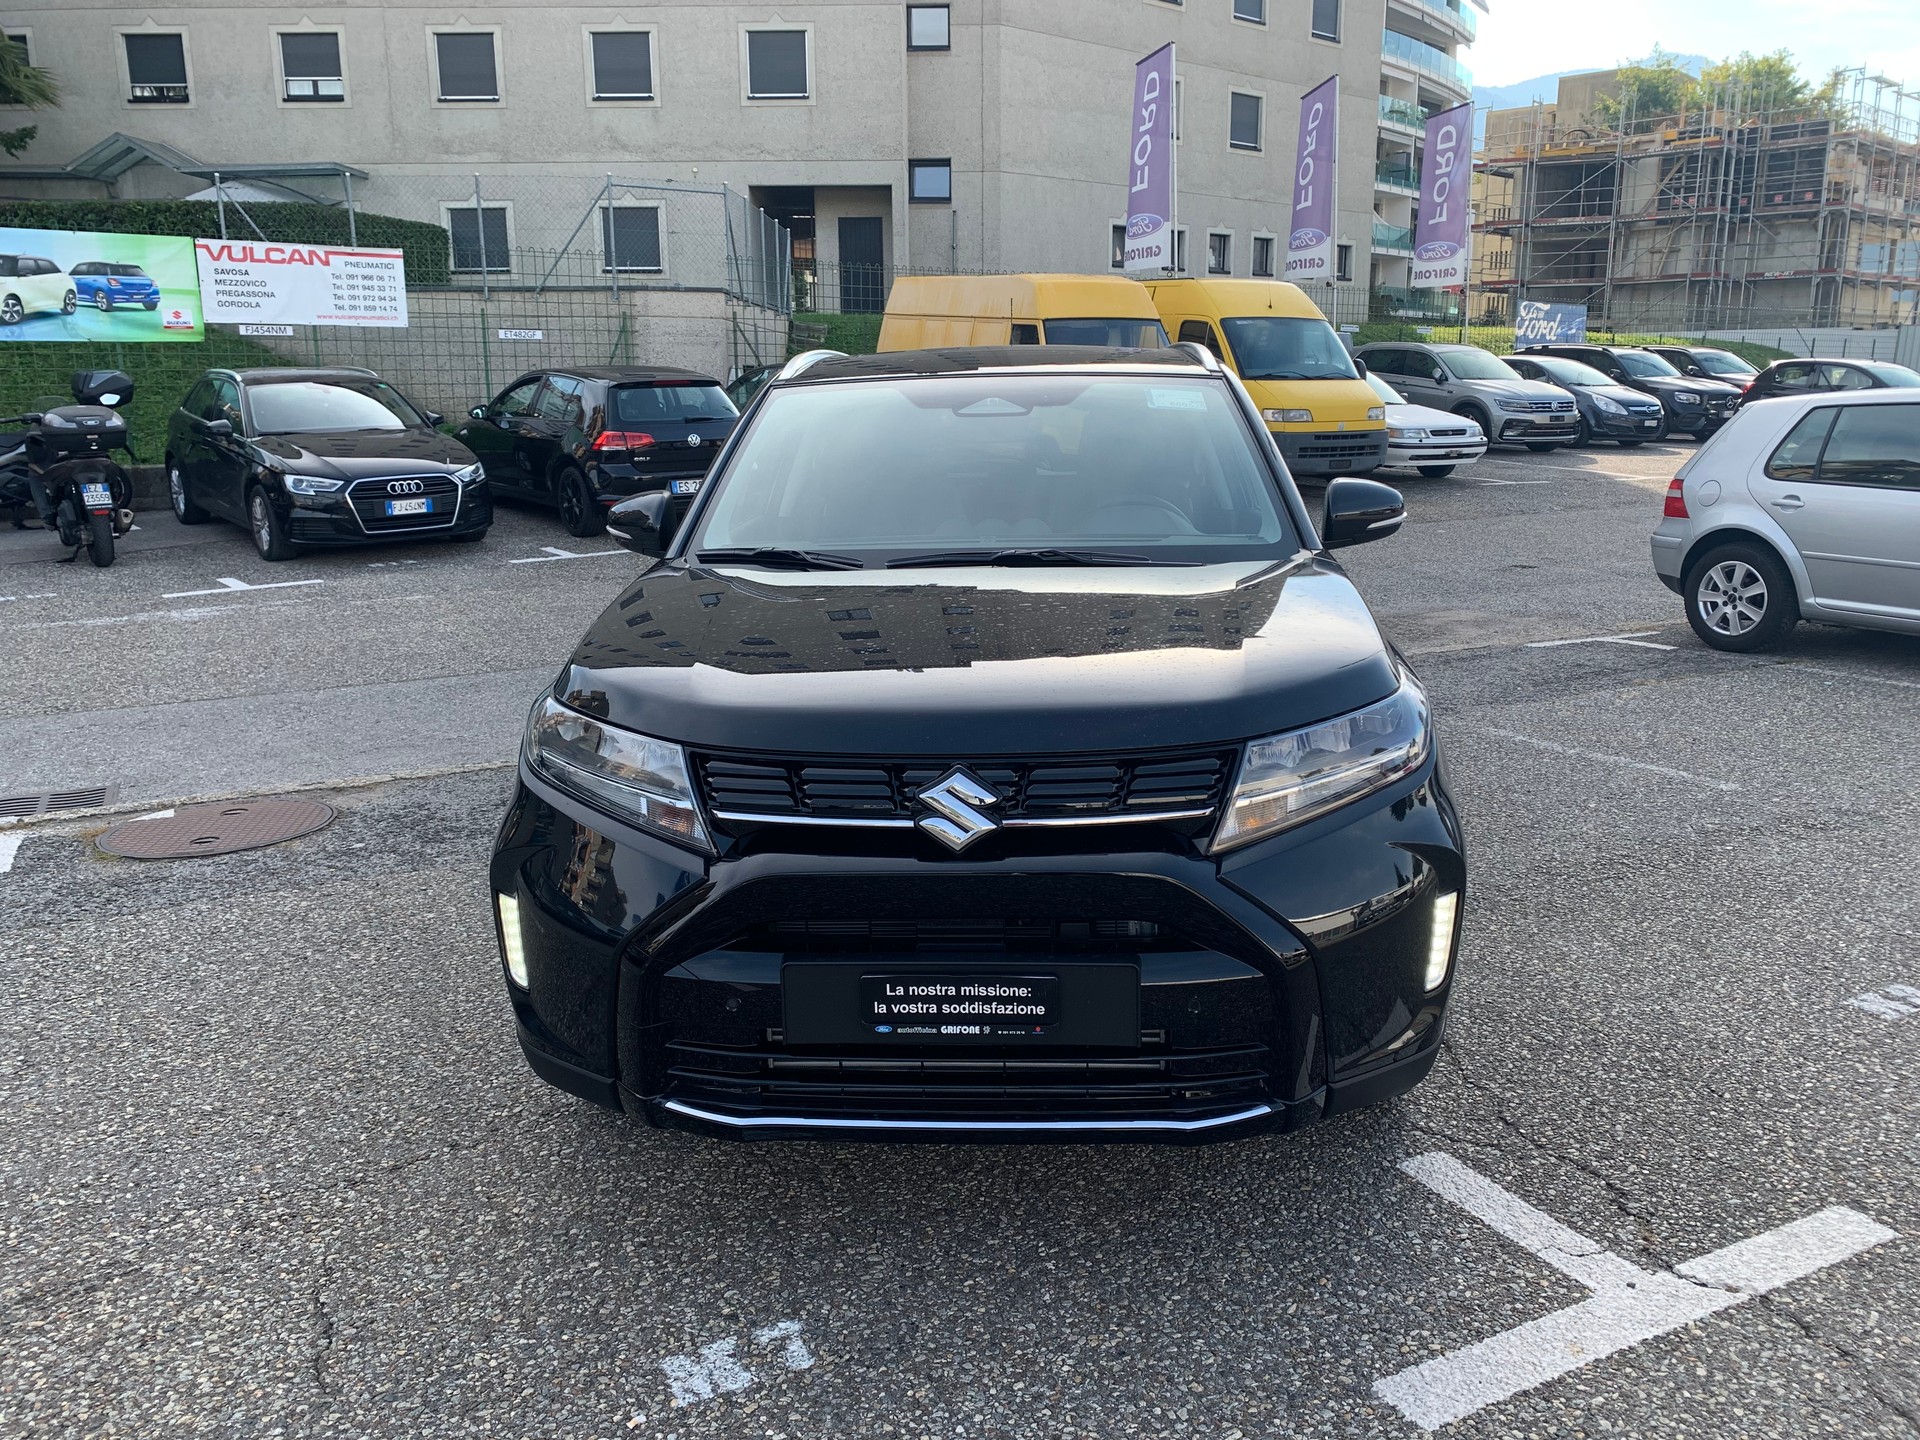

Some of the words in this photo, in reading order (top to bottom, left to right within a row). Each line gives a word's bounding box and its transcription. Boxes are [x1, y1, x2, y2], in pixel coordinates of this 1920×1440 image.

[205, 244, 331, 267] VULCAN
[344, 261, 395, 270] PNEUMATICI
[213, 268, 250, 276] SAVOSA
[214, 279, 267, 288] MEZZOVICO
[216, 290, 276, 298] PREGASSONA
[332, 293, 346, 301] Tel.
[217, 300, 261, 309] GORDOLA
[333, 303, 347, 311] Tel.
[1515, 301, 1561, 341] Ford
[245, 325, 288, 335] FJ454NM
[886, 983, 904, 996] La
[909, 983, 956, 996] nostra
[961, 983, 1032, 997] missione:
[874, 1001, 887, 1013] la
[891, 1001, 937, 1014] vostra
[942, 1001, 1045, 1015] soddisfazione
[940, 1025, 980, 1034] GRIFONE
